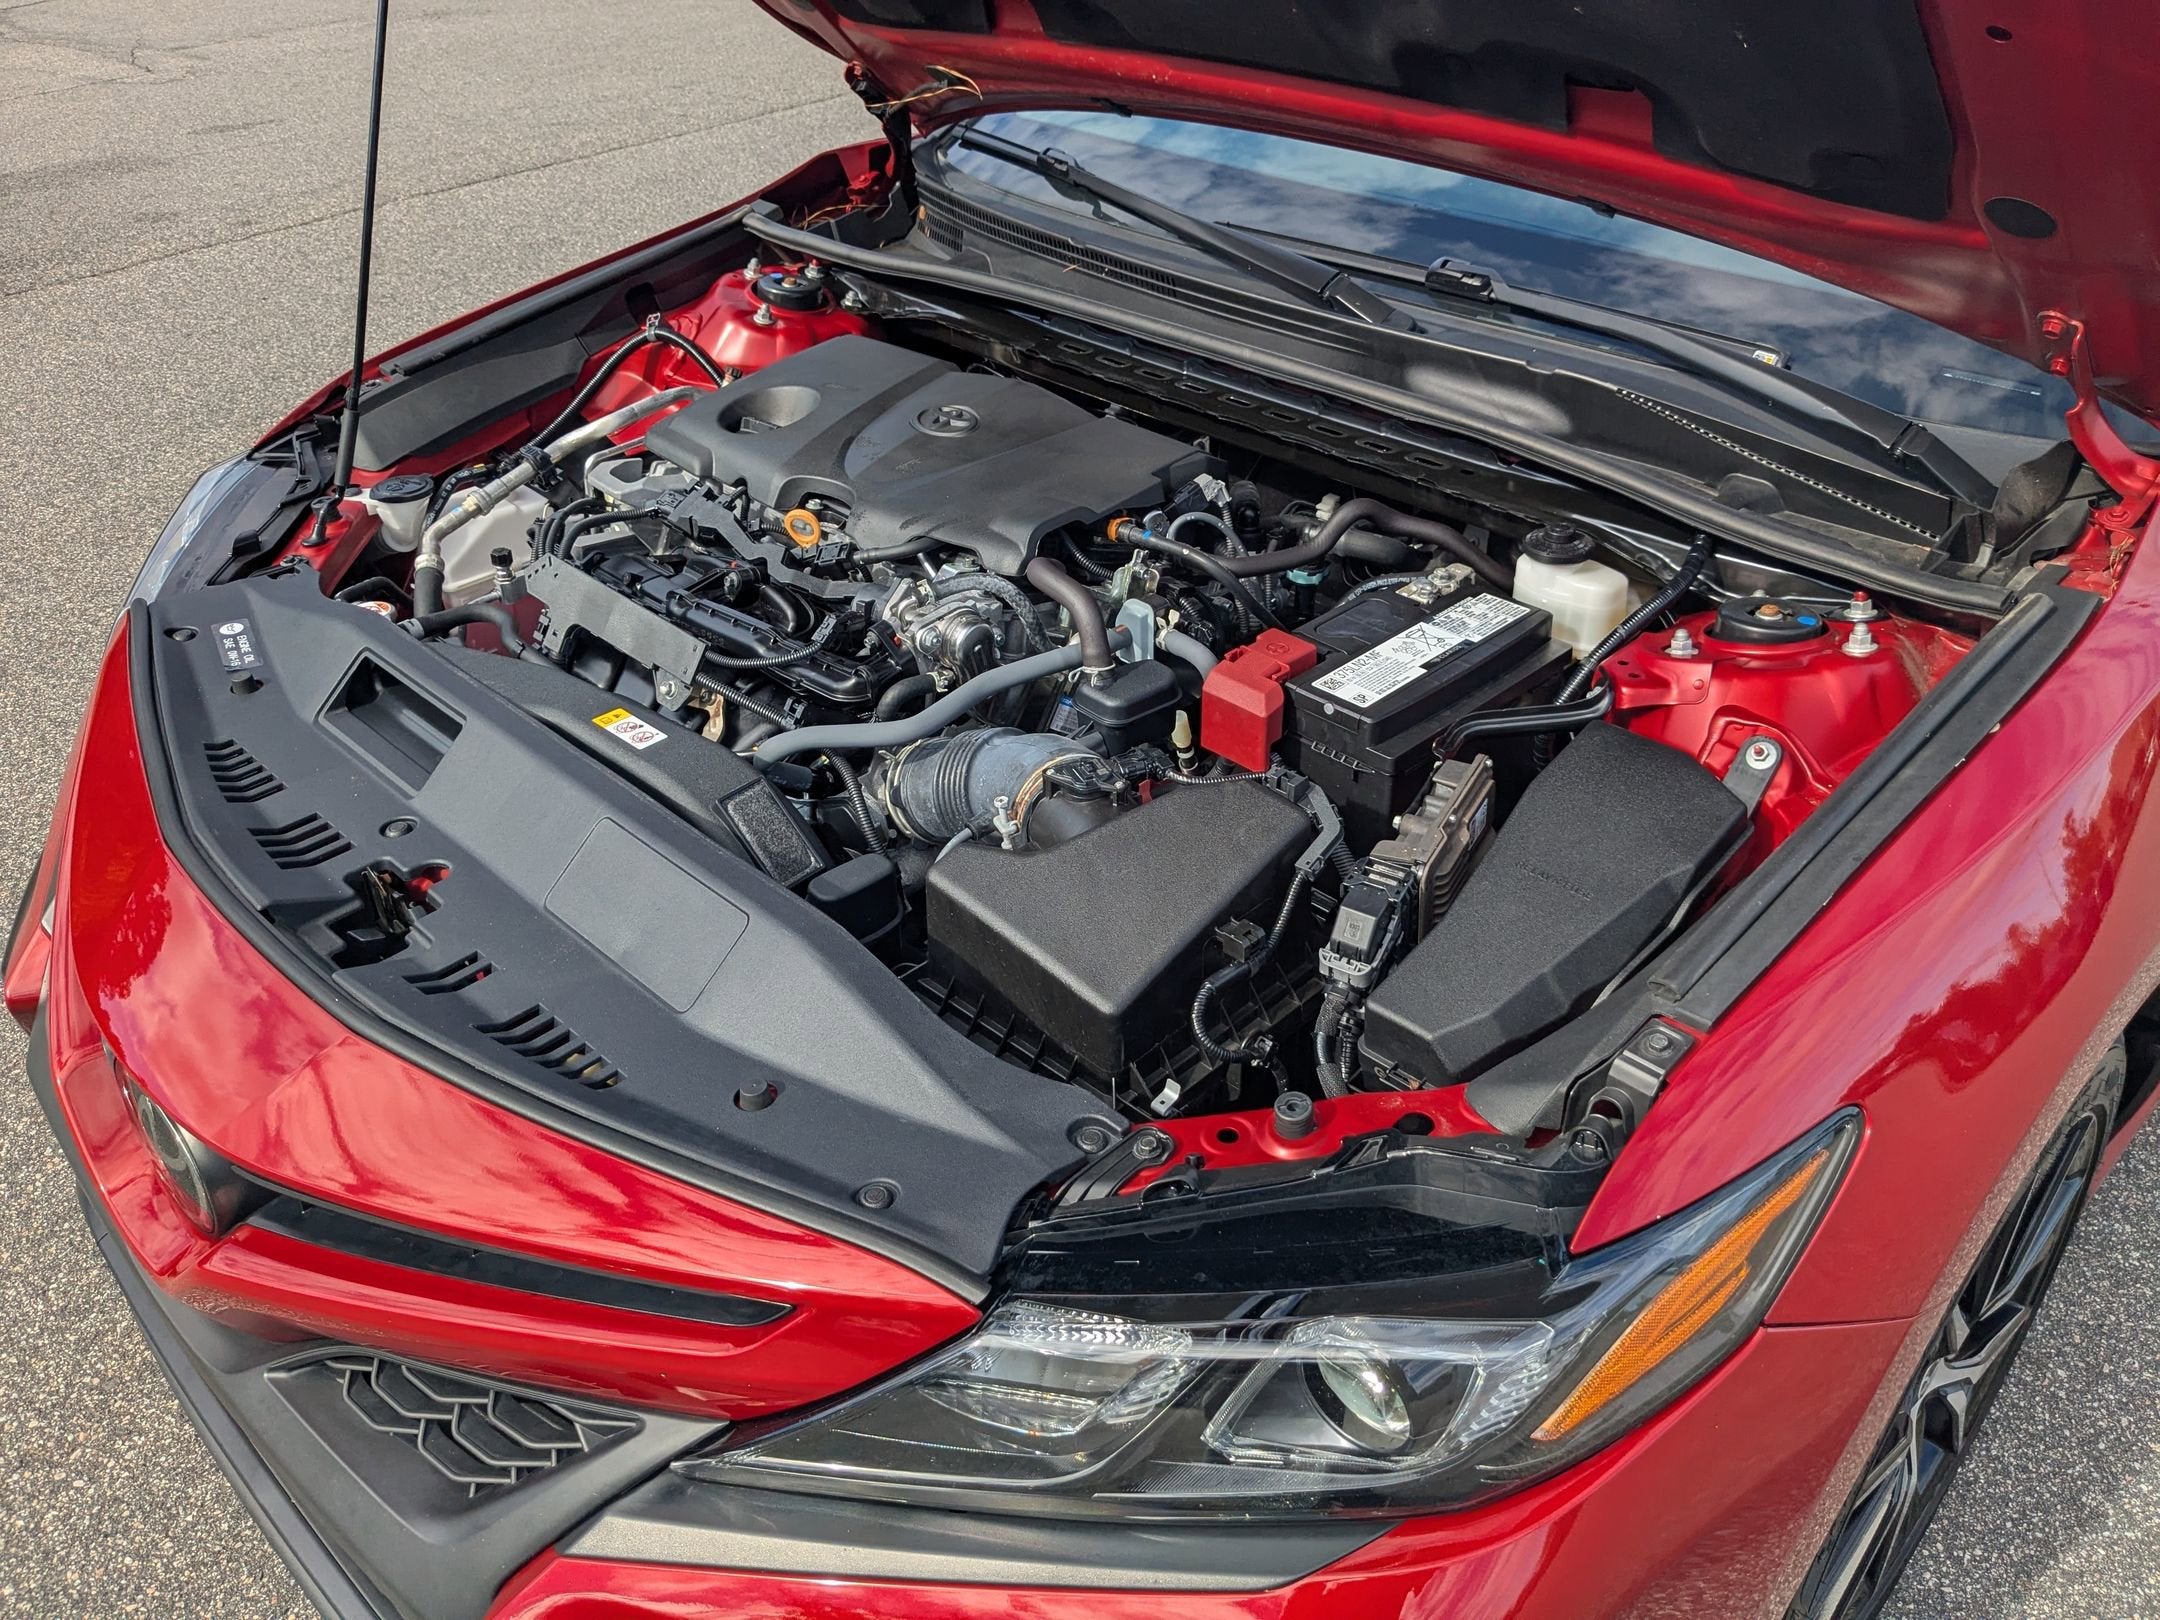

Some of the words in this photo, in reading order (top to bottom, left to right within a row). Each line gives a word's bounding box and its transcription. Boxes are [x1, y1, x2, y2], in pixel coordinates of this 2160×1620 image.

[223, 637, 236, 649] SAE
[236, 634, 252, 653] ENGINE
[227, 650, 242, 667] 0W-16
[243, 654, 255, 664] OIL
[1333, 649, 1383, 679] 375LN2-MF
[1352, 693, 1369, 704] SP
